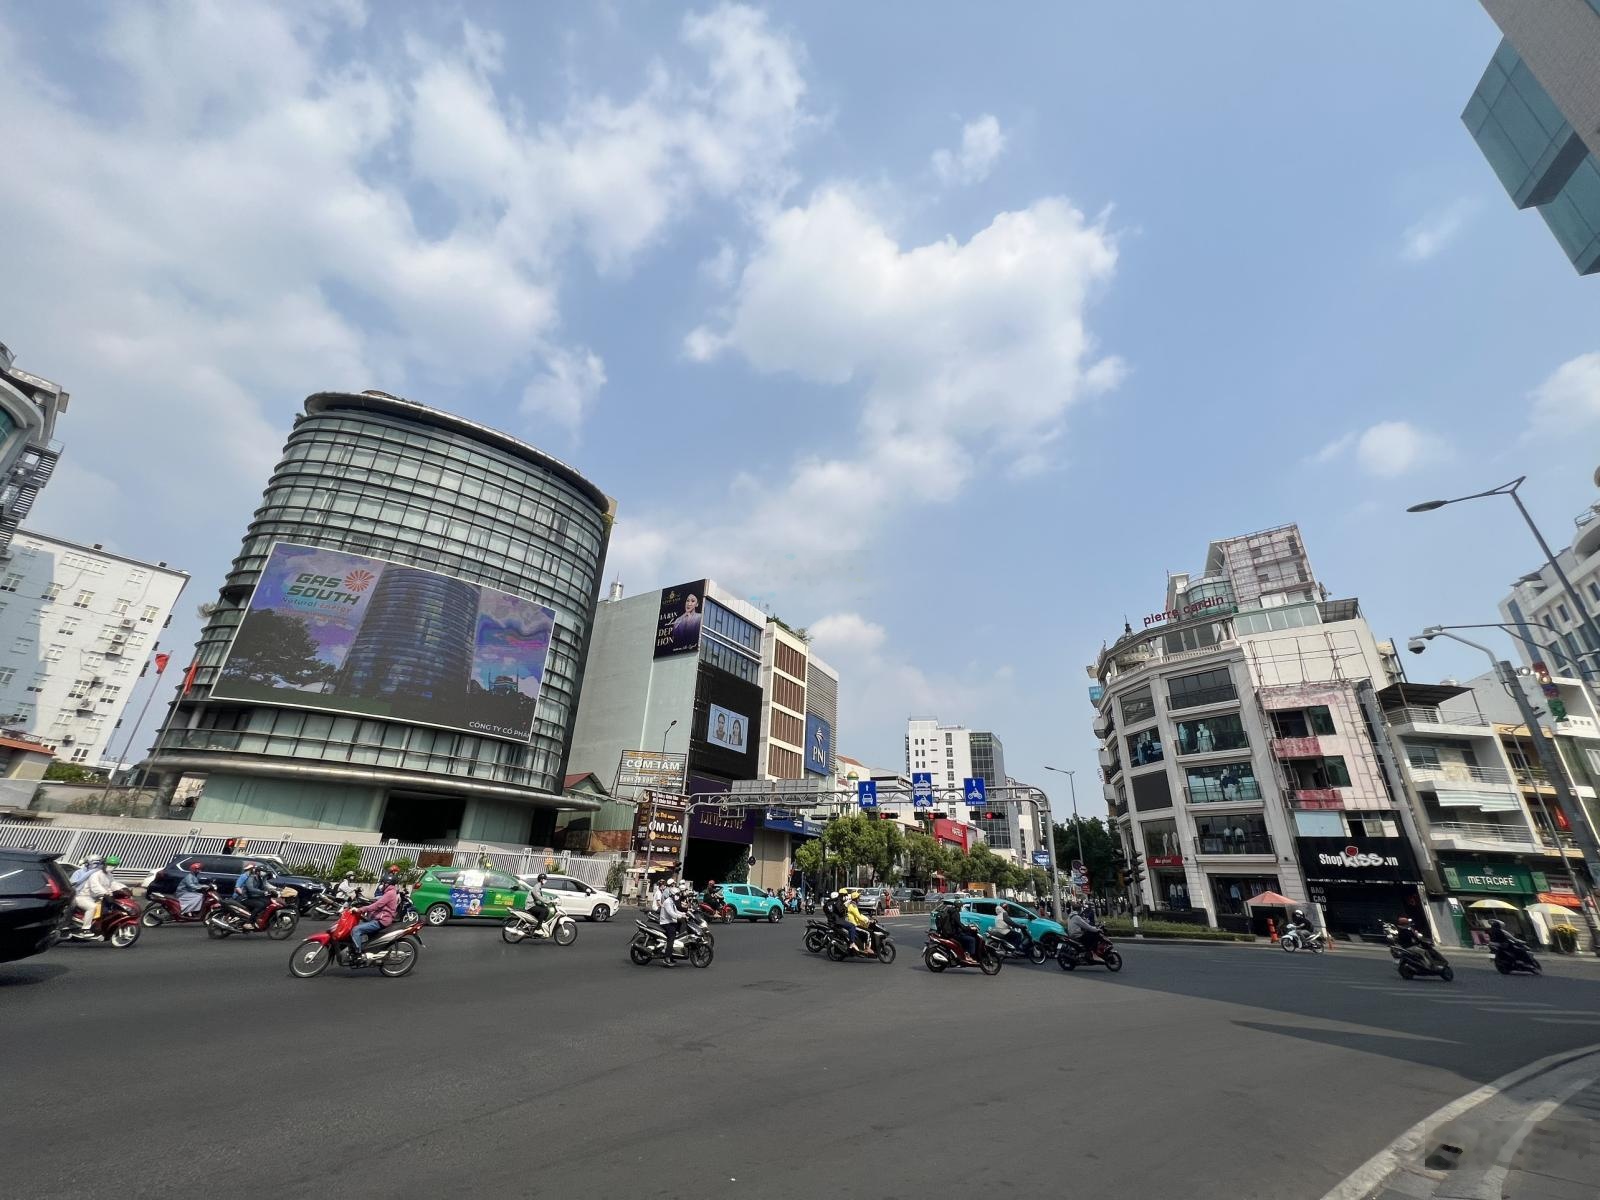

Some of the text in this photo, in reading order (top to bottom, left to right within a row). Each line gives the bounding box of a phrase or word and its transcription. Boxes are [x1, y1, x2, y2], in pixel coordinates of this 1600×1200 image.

[295, 573, 342, 588] GAS
[287, 585, 361, 605] SOUTH
[1143, 596, 1225, 627] pierre cardin
[469, 721, 491, 731] CÔNG
[812, 745, 826, 768] PNJ
